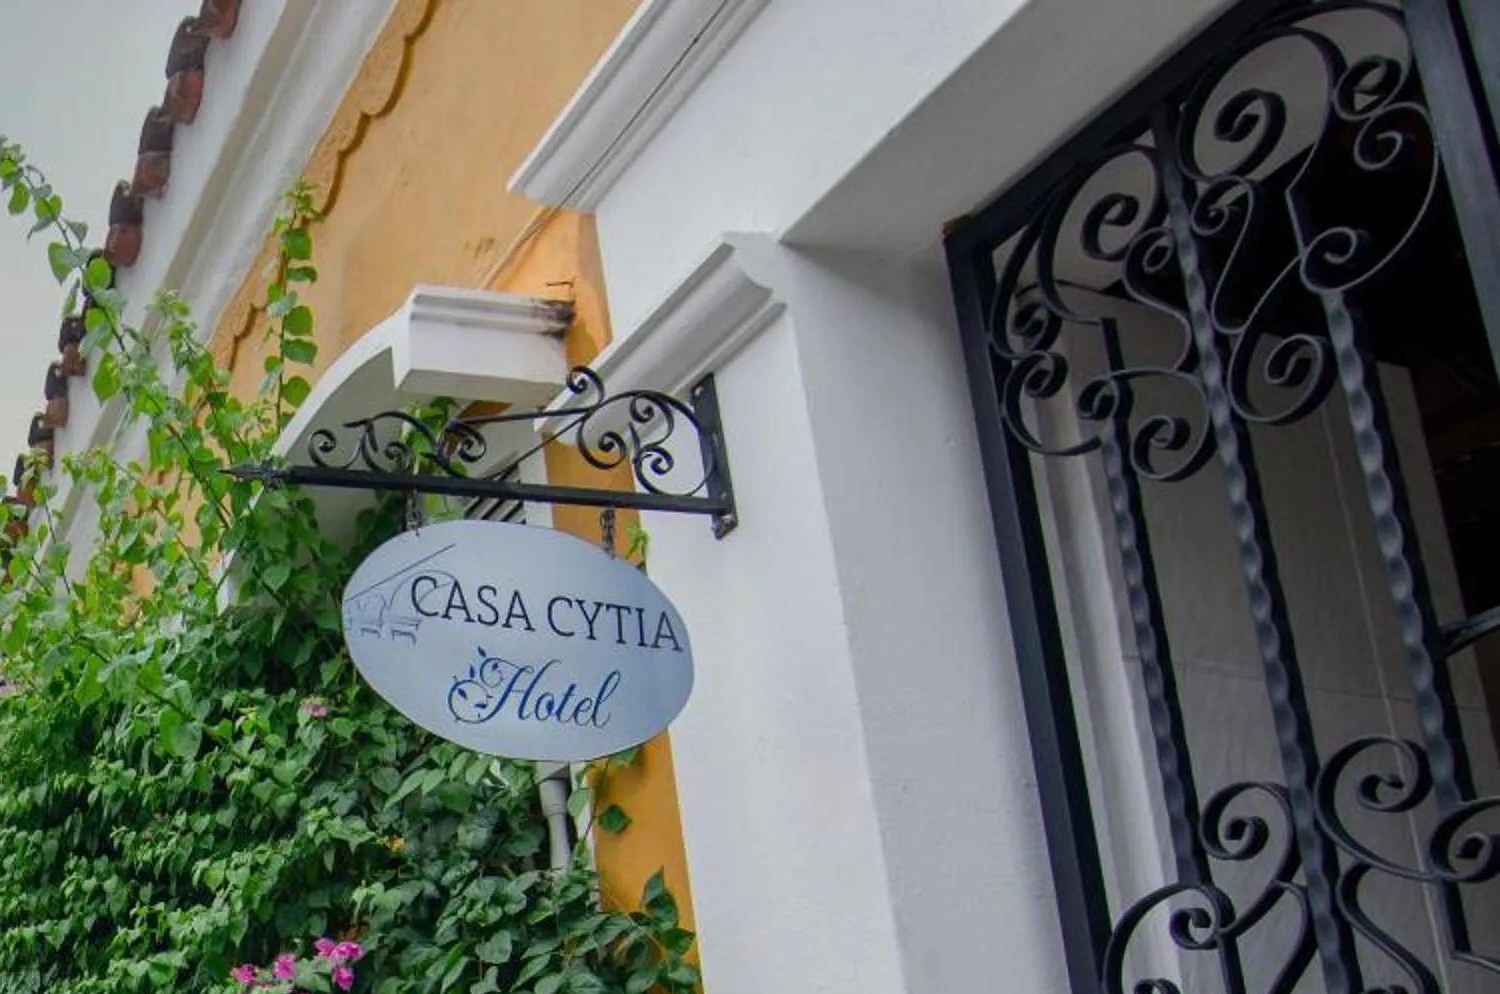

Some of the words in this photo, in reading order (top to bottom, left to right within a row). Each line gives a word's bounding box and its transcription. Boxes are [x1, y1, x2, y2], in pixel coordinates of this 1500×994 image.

[410, 573, 536, 632] CASA
[546, 596, 684, 653] CYTIA
[448, 653, 621, 728] Hotel
